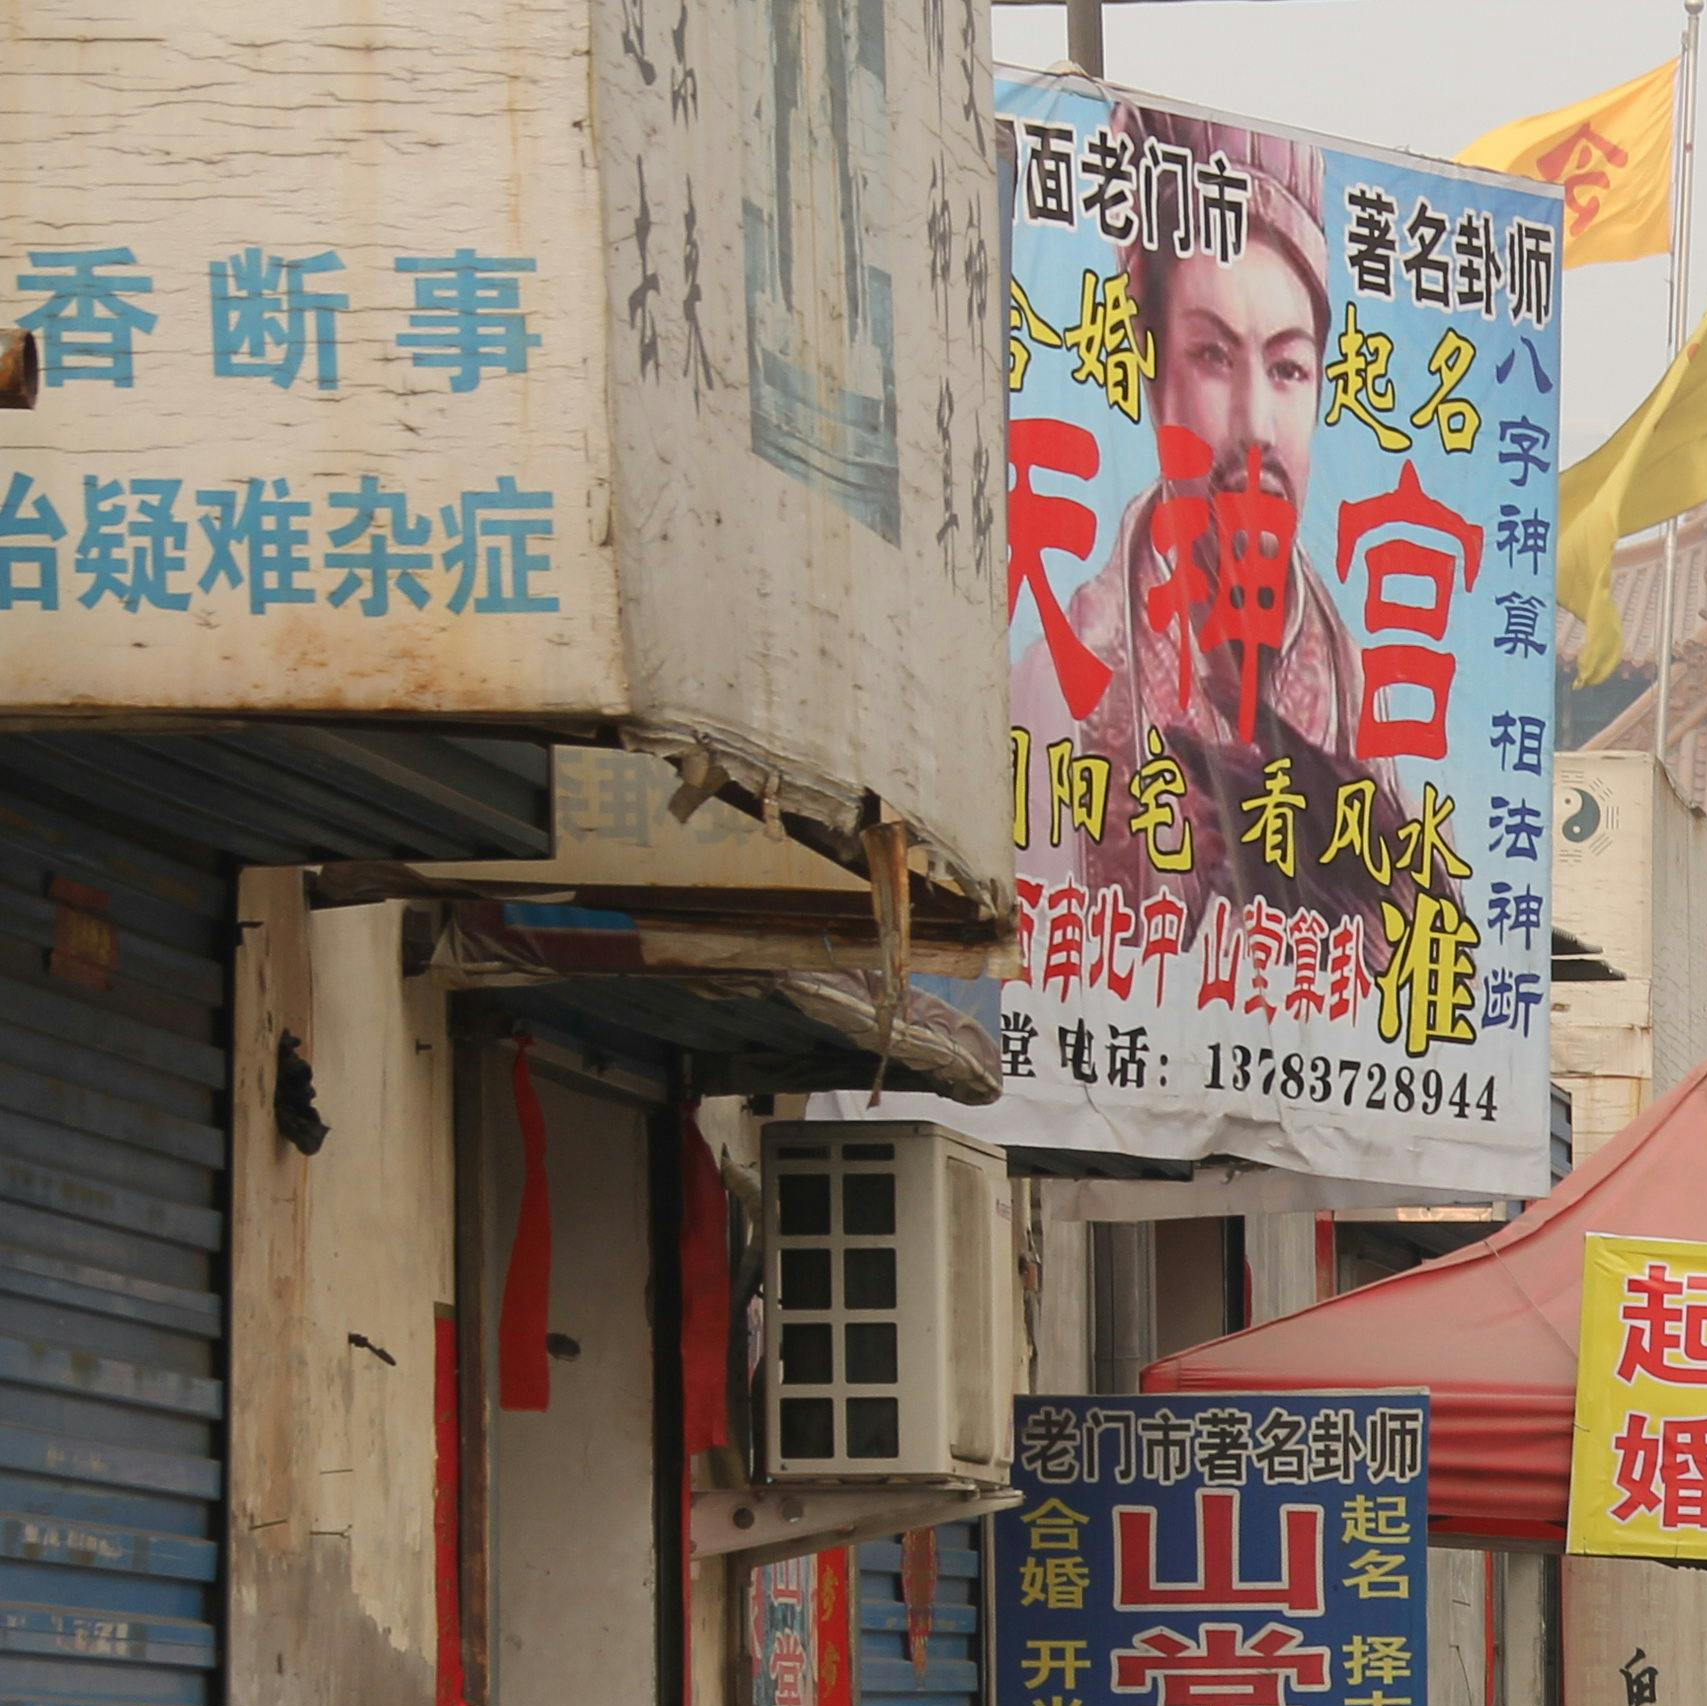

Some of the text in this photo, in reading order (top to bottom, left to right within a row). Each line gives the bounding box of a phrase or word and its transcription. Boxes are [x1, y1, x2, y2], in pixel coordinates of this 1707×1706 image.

[994, 118, 1556, 327] 面老门市 著名卦师
[16, 247, 542, 392] 香断事
[1326, 301, 1483, 454] 起名
[1480, 336, 1556, 1039] 八字神算 相法神断
[1008, 725, 1475, 890] 阳宅 看风水
[1197, 893, 1374, 1026] 山堂算卦
[1376, 892, 1482, 1058] 准
[1204, 1040, 1499, 1123] 13783728944
[1021, 1406, 1423, 1486] 老门市著名卦师
[1020, 1496, 1092, 1611] 合婚
[1341, 1493, 1412, 1602] 起名
